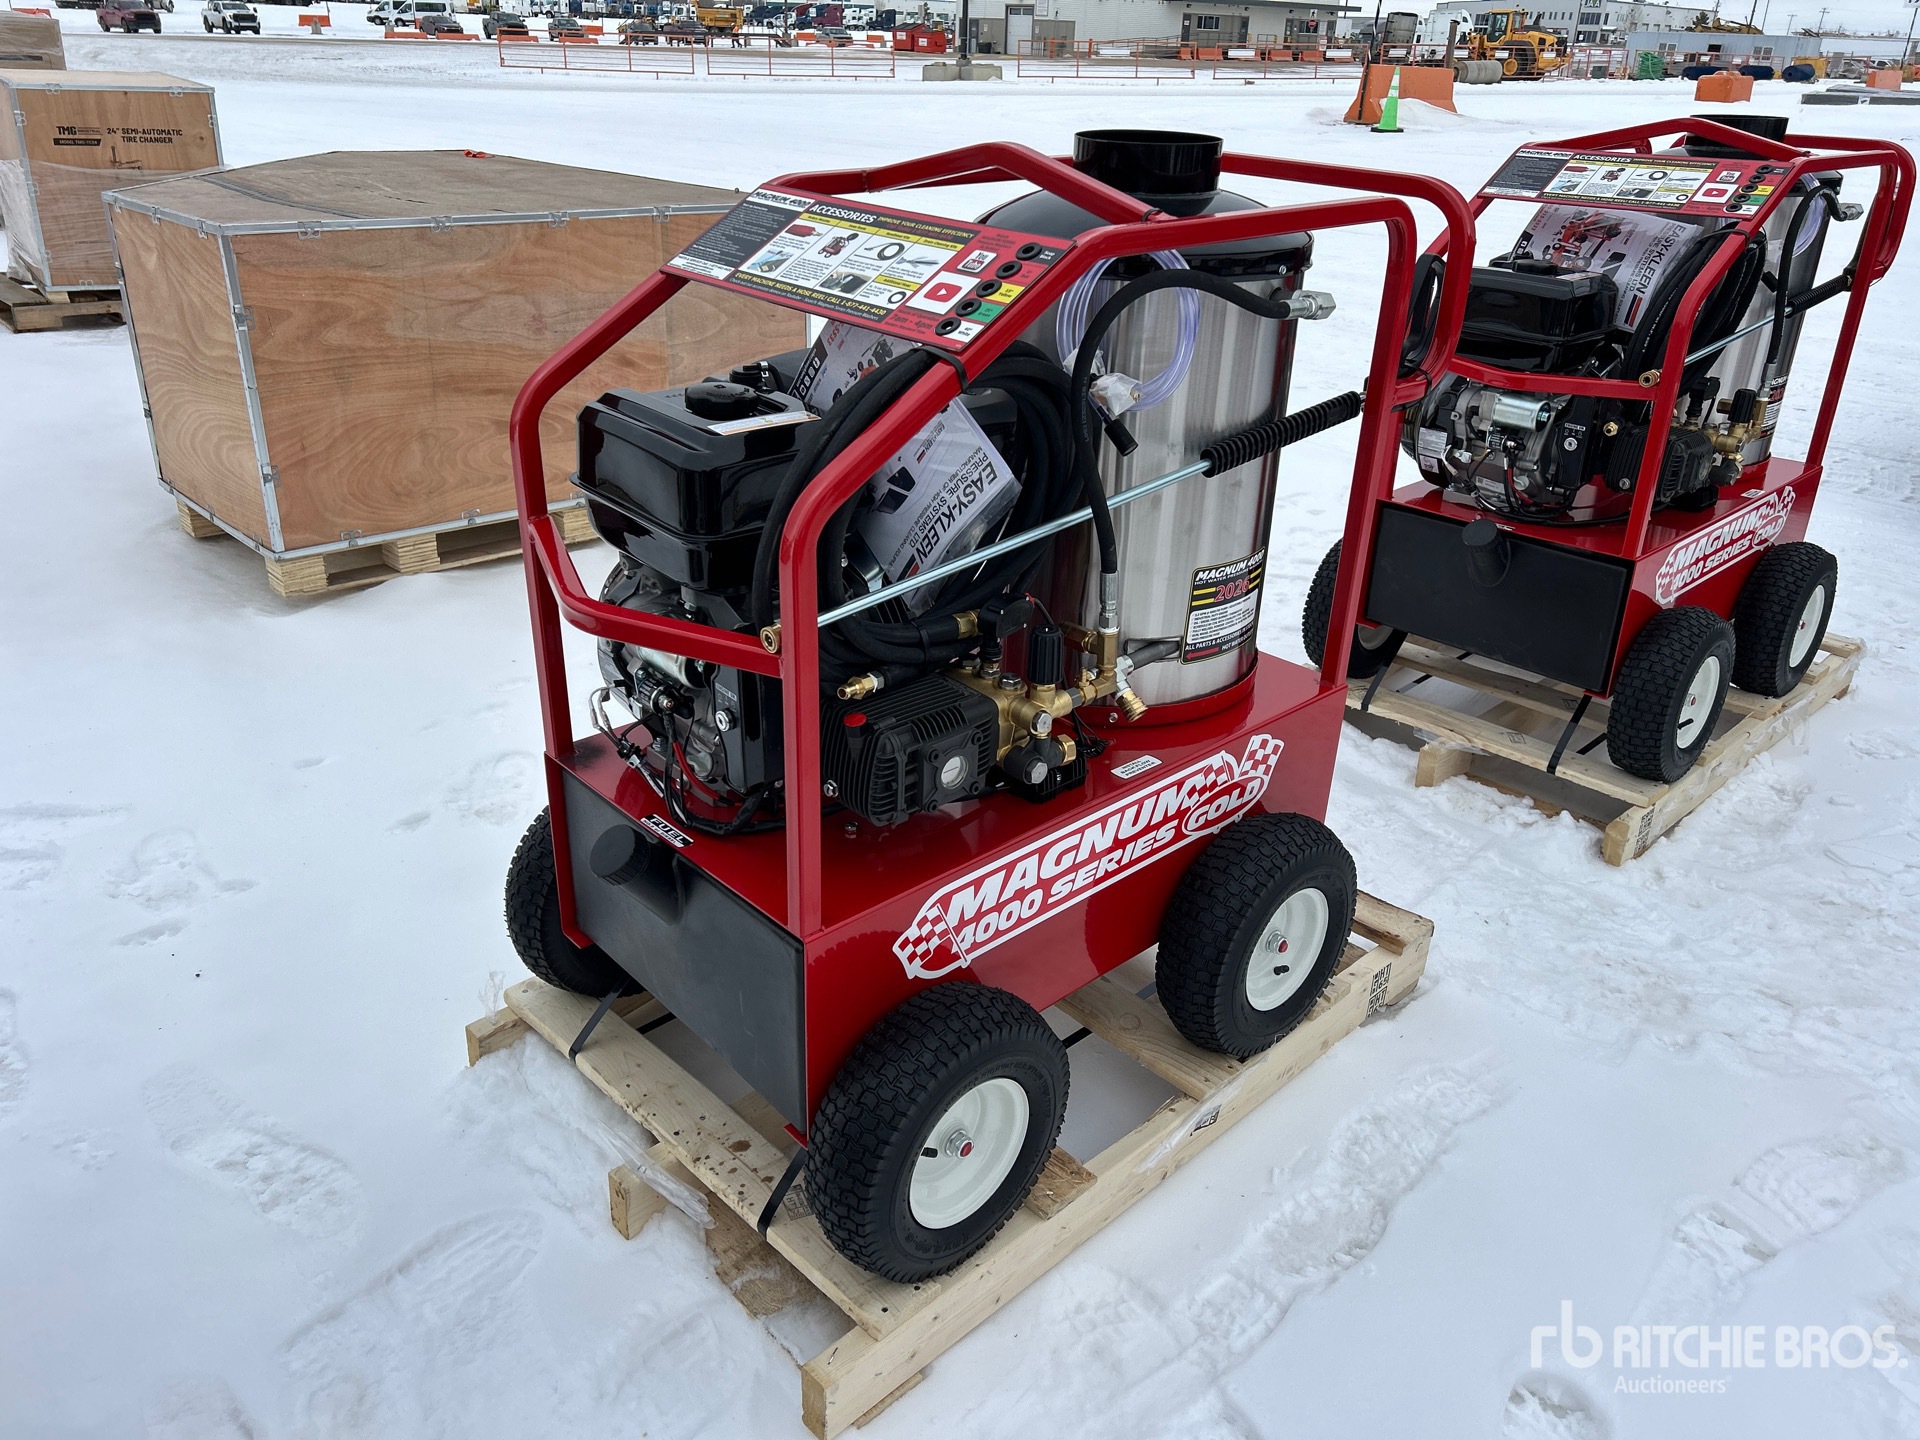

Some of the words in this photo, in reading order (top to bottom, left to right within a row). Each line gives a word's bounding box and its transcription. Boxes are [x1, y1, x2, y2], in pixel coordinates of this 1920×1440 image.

[56, 126, 77, 135] TMG
[752, 190, 790, 204] MAGNUM
[810, 204, 877, 223] ACCESSORIES
[914, 223, 942, 232] CLEANING
[940, 228, 974, 238] EFFICIENCY
[1636, 224, 1686, 294] EASY-KLEEN
[750, 276, 775, 286] MACHINE
[890, 314, 910, 323] 7am
[946, 452, 989, 498] PRESSURE
[915, 461, 998, 564] EASY-KLEEN
[920, 496, 948, 534] SYSTEMS
[1755, 518, 1782, 543] GOLD
[1672, 505, 1765, 571] MAGNUM
[1703, 534, 1752, 573] SERIES
[1196, 560, 1248, 581] MAGNUM
[1125, 762, 1155, 776] PREVENTER
[1187, 779, 1259, 832] GOLD
[649, 817, 684, 844] FUEL
[946, 774, 1208, 927] MAGNUM
[950, 888, 1047, 954] 4000
[1047, 819, 1180, 904] SERIES
